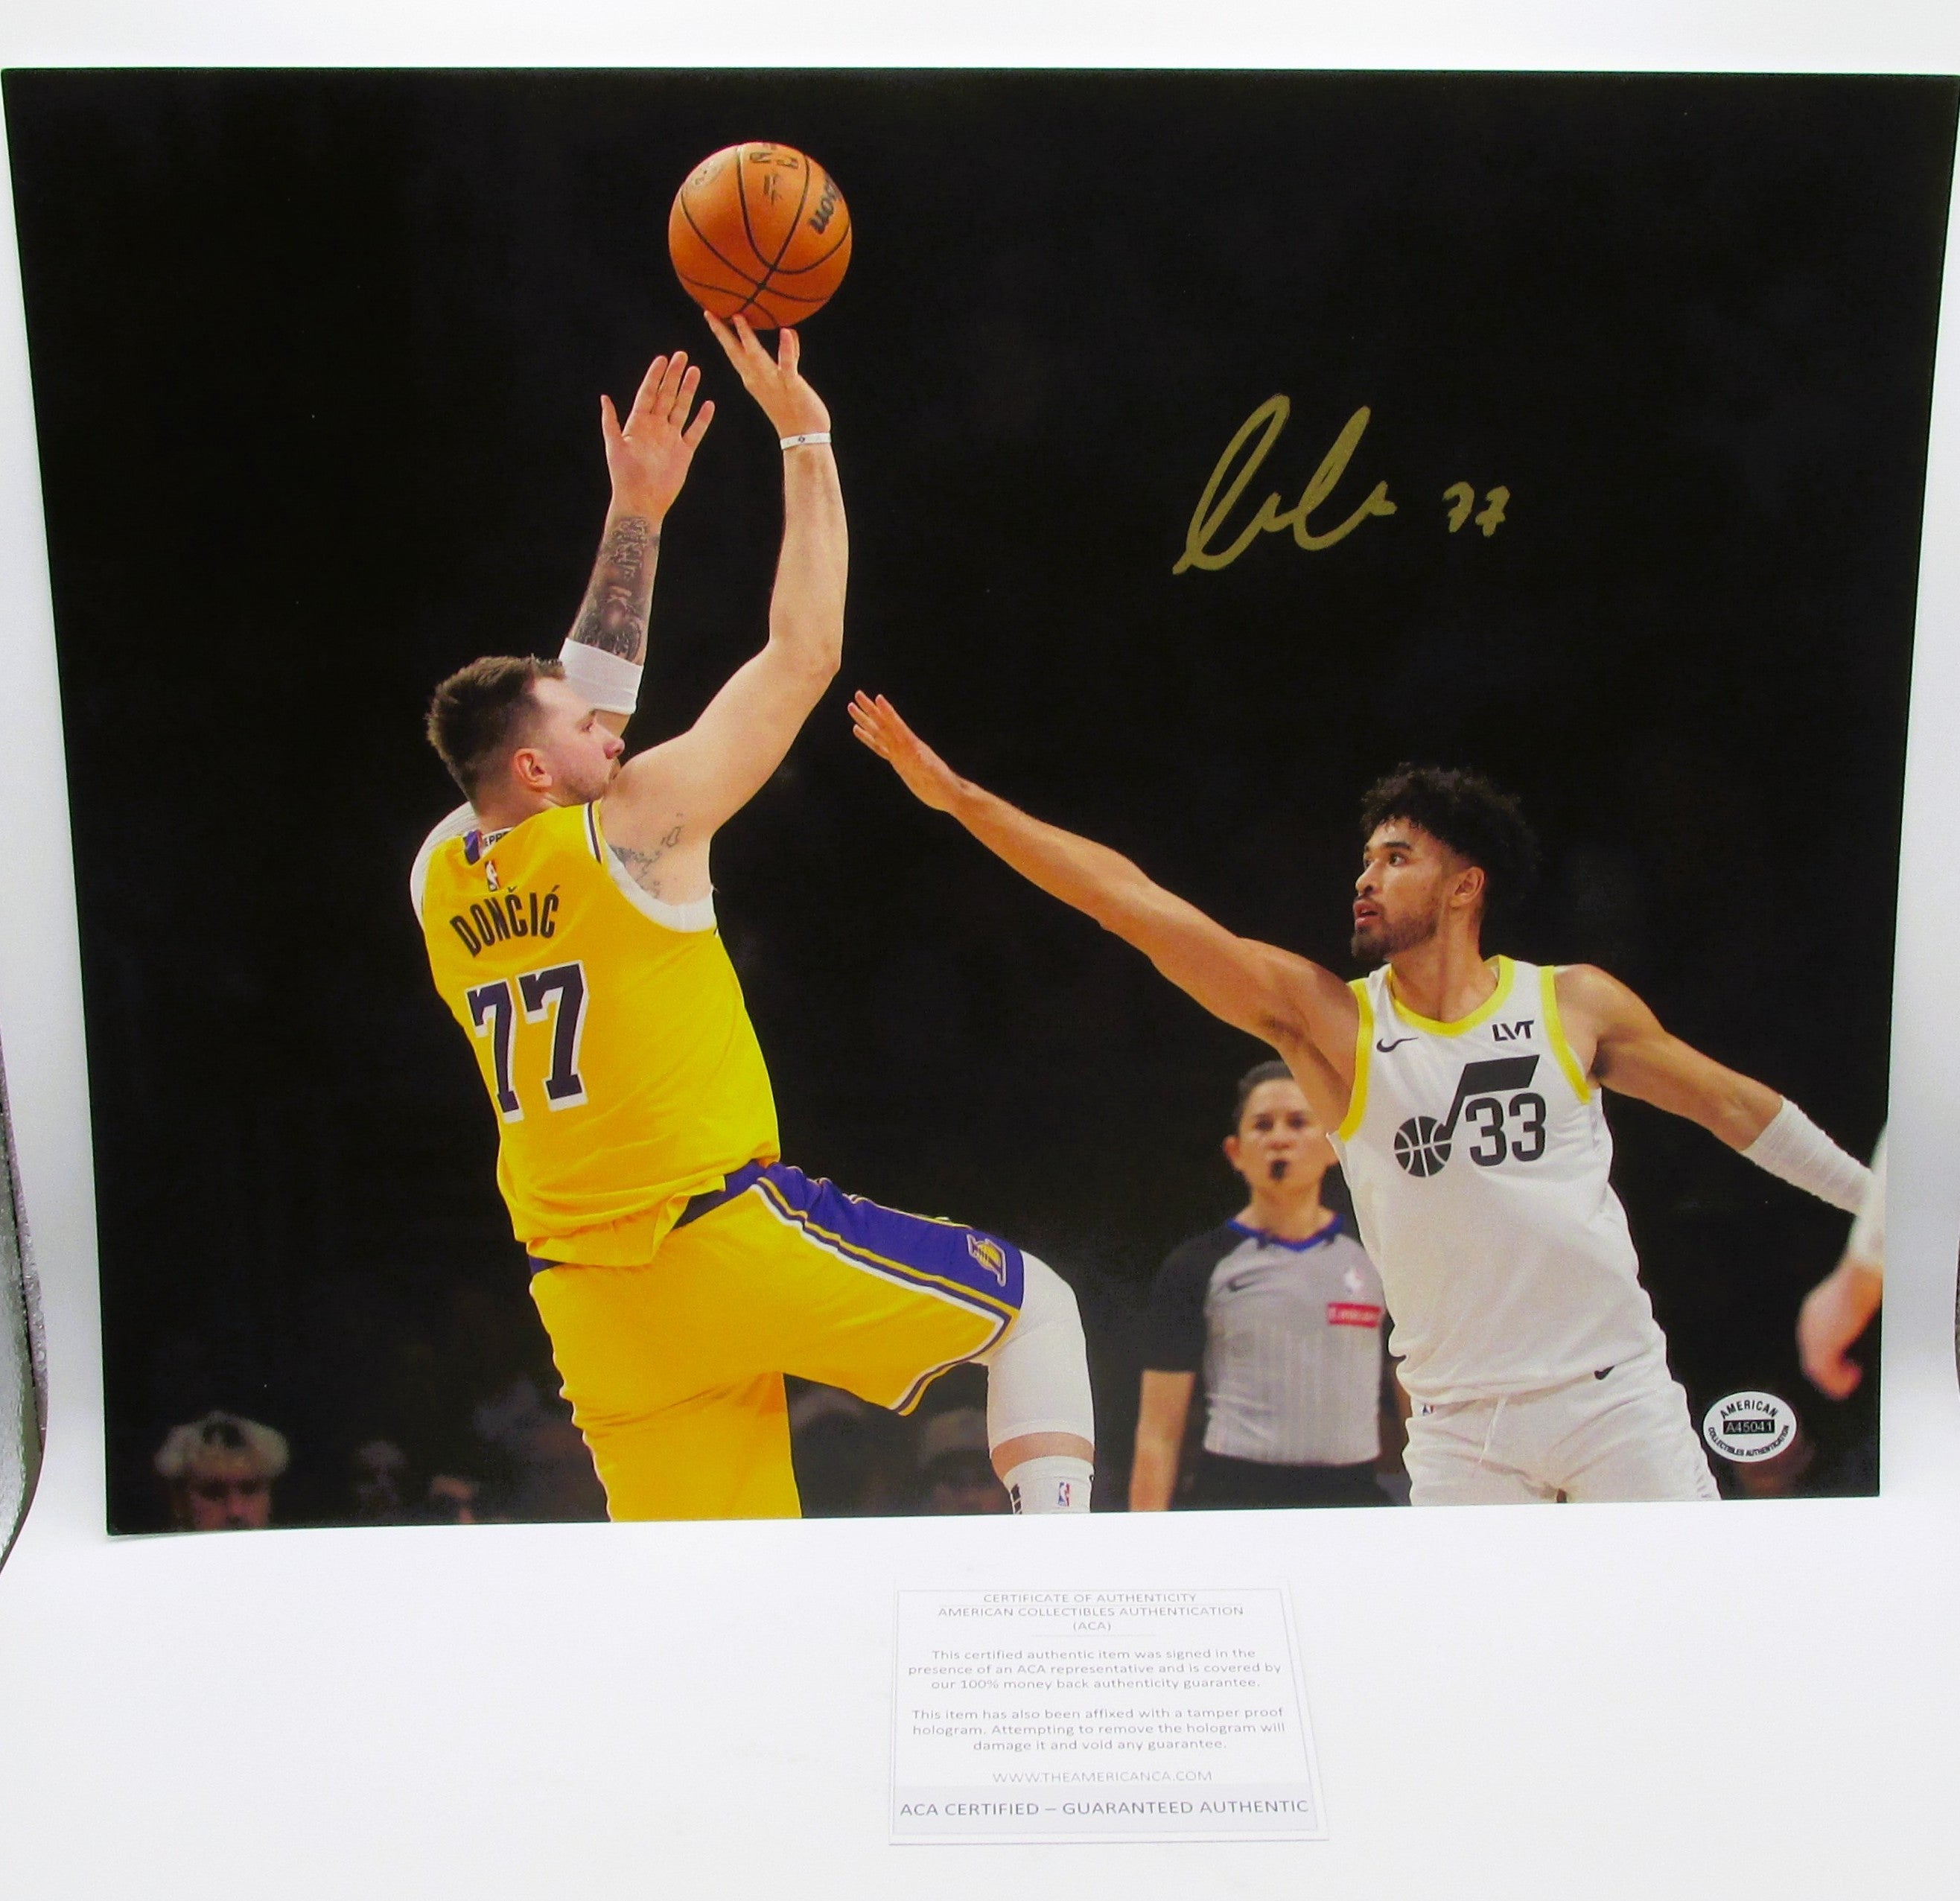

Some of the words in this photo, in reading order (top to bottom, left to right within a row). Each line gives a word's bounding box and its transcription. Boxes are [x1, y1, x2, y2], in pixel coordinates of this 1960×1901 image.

[449, 885, 560, 958] DONČIĆ
[1492, 1020, 1535, 1042] LVT
[465, 960, 588, 1122] 77
[1466, 1092, 1547, 1167] 33
[1720, 1400, 1778, 1419] AMERICAN
[1725, 1421, 1773, 1433] A45041
[1708, 1427, 1745, 1456] COLLECTIBLES
[1746, 1425, 1789, 1457] AUTHENTICATION
[983, 1594, 1069, 1603] CERTIFICATE
[1074, 1594, 1092, 1603] OF
[1097, 1593, 1196, 1602] AUTHENTICITY
[938, 1608, 1013, 1617] AMERICAN
[1018, 1607, 1115, 1617] COLLECTIBLES
[1120, 1606, 1243, 1616] AUTHENTICATION
[1073, 1622, 1111, 1632] (ACA)
[932, 1650, 960, 1660] This
[964, 1649, 1022, 1660] certified
[1028, 1650, 1094, 1660] authentic
[1098, 1649, 1130, 1659] item
[1134, 1651, 1161, 1659] was
[1166, 1649, 1211, 1660] signed
[1215, 1649, 1227, 1658] in
[1232, 1649, 1256, 1658] the
[909, 1666, 972, 1677] presence
[977, 1664, 992, 1674] of
[1017, 1664, 1046, 1674] ACA
[1051, 1664, 1154, 1677] representative
[1159, 1663, 1184, 1673] and
[1189, 1663, 1199, 1672] is
[1204, 1663, 1260, 1672] covered
[1265, 1662, 1281, 1674] by
[961, 1679, 999, 1689] 100%
[1004, 1680, 1052, 1690] money
[1057, 1678, 1089, 1689] back
[1094, 1678, 1179, 1690] authenticity
[1184, 1679, 1260, 1690] guarantee.
[911, 1710, 941, 1719] This
[946, 1710, 978, 1719] item
[983, 1710, 1007, 1719] has
[1012, 1710, 1040, 1719] also
[1045, 1710, 1080, 1719] been
[1086, 1708, 1133, 1719] affixed
[1139, 1708, 1169, 1718] with
[1187, 1709, 1239, 1721] tamper
[1244, 1707, 1284, 1720] proof
[913, 1725, 986, 1737] hologram.
[992, 1725, 1075, 1736] Attempting
[1079, 1725, 1093, 1733] to
[1158, 1723, 1182, 1733] the
[1187, 1723, 1256, 1735] hologram
[1260, 1722, 1285, 1733] will
[973, 1740, 1031, 1752] damage
[1037, 1740, 1046, 1750] it
[1051, 1739, 1077, 1750] and
[1082, 1739, 1113, 1750] void
[1118, 1742, 1143, 1751] any
[1148, 1739, 1226, 1751] guarantee.
[900, 1803, 938, 1817] ACA
[945, 1803, 1039, 1815] CERTIFIED
[1063, 1801, 1193, 1815] GUARANTEED
[1200, 1800, 1309, 1813] AUTHENTIC
